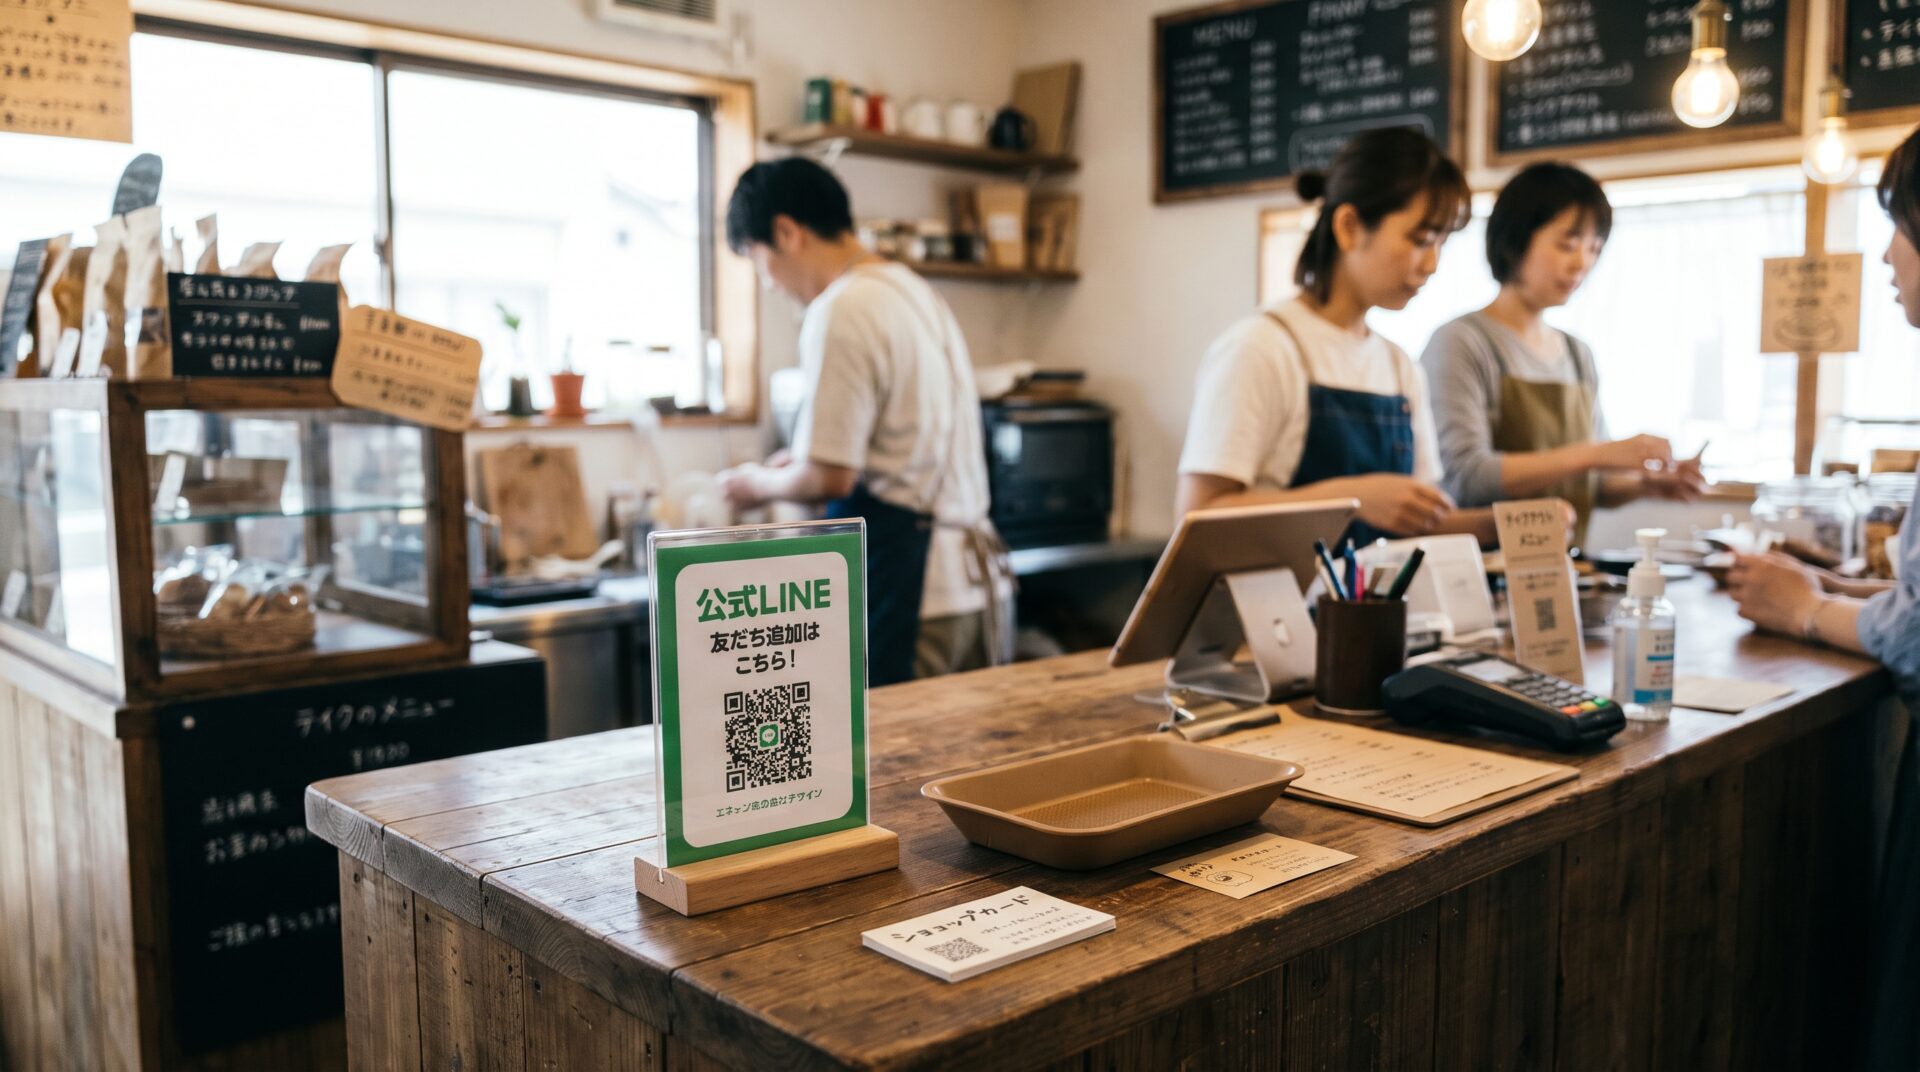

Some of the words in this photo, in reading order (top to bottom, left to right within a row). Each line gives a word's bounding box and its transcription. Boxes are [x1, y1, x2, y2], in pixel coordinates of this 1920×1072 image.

[696, 578, 831, 623] 公式LINE
[710, 621, 820, 653] 友だち追加は
